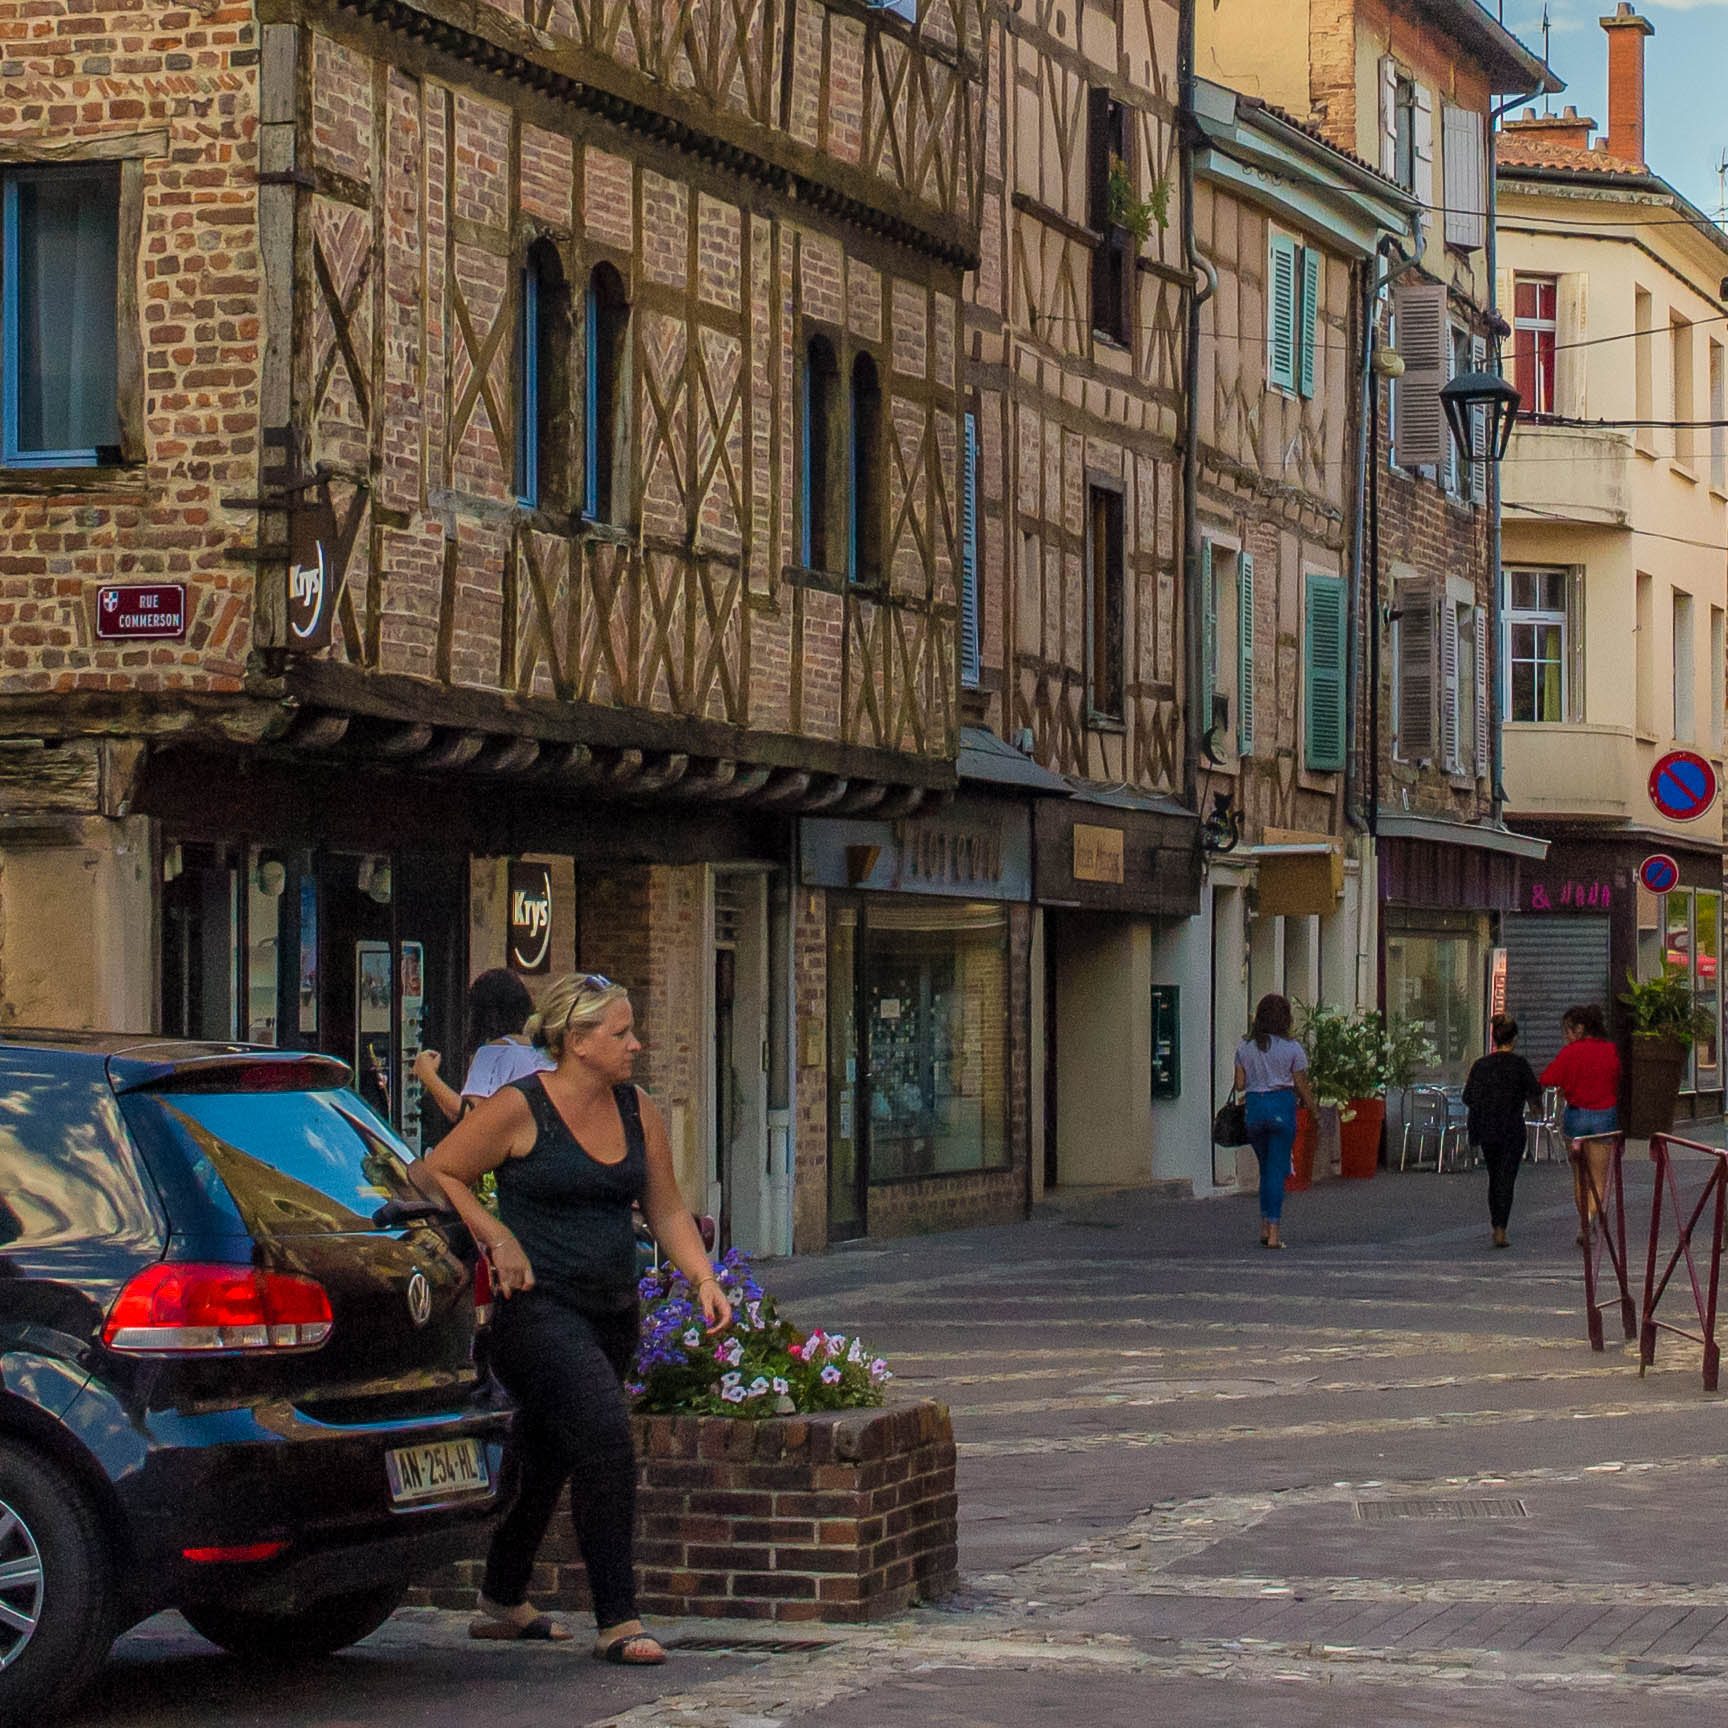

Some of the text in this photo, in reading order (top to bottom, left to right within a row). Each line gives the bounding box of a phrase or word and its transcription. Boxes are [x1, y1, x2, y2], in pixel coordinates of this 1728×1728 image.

[139, 594, 159, 609] RUE
[118, 613, 180, 629] COMMERSON
[1531, 884, 1552, 910] &
[513, 890, 548, 937] Krys
